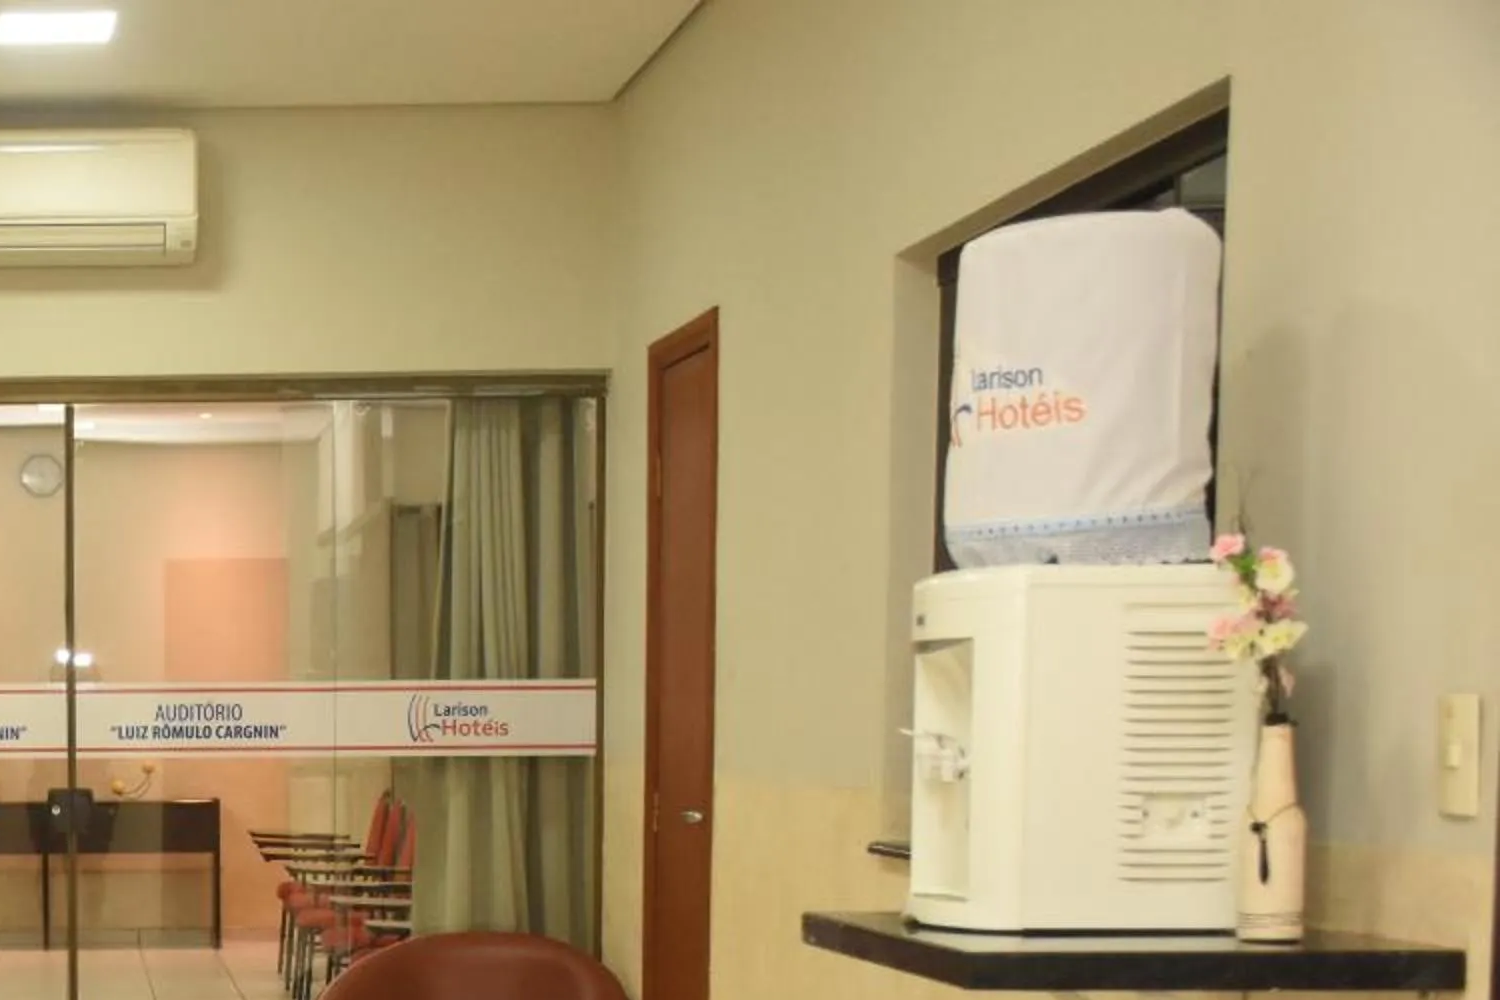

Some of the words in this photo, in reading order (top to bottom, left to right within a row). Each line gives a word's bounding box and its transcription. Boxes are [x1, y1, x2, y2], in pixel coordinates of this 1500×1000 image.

[976, 392, 1085, 432] Hotéis
[155, 701, 243, 721] AUDITÓRIO
[433, 702, 488, 717] Larison
[441, 718, 509, 737] Hotéis
